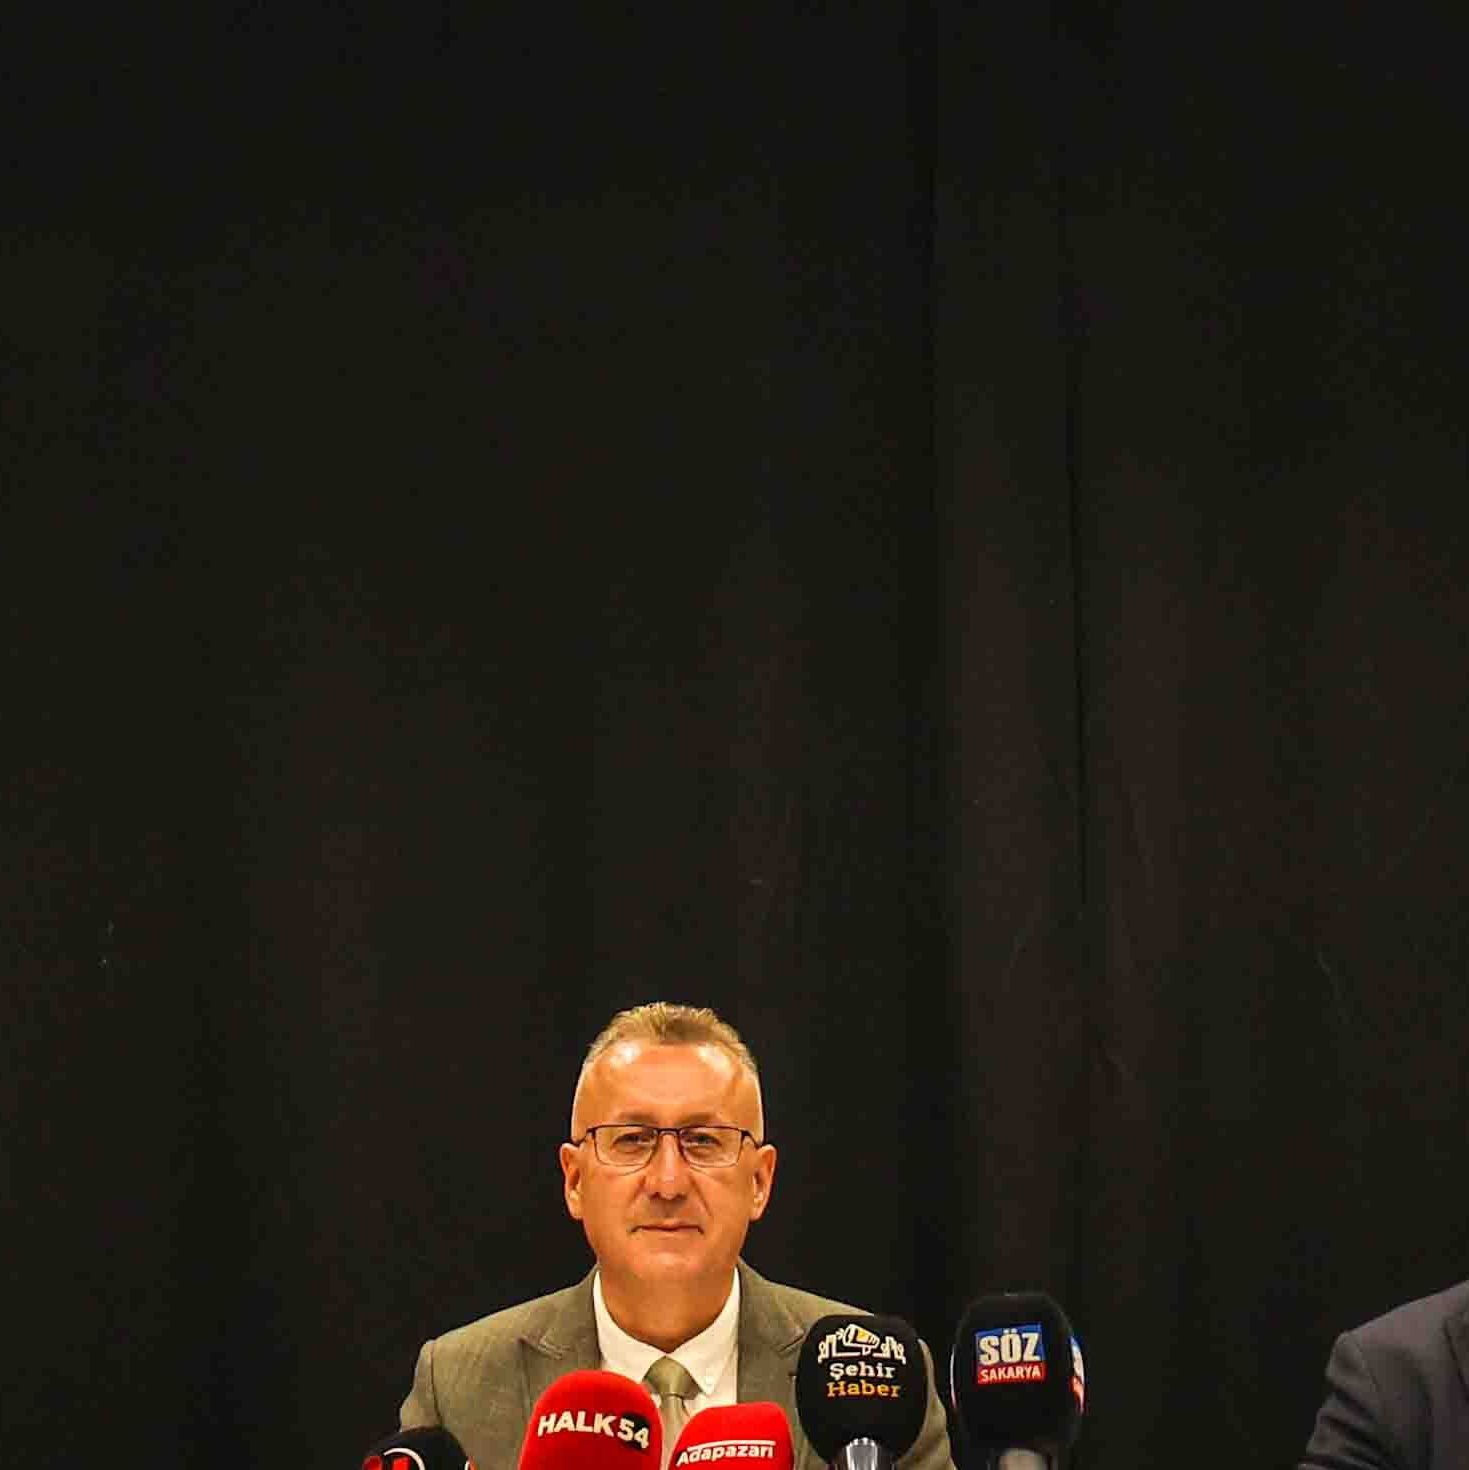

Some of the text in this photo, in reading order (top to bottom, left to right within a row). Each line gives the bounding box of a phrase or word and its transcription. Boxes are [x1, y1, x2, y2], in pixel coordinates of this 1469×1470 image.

[979, 1329, 1043, 1366] SÖZ
[829, 1361, 896, 1379] Şehir
[980, 1365, 1042, 1383] SAKARYA
[826, 1381, 901, 1398] Haber
